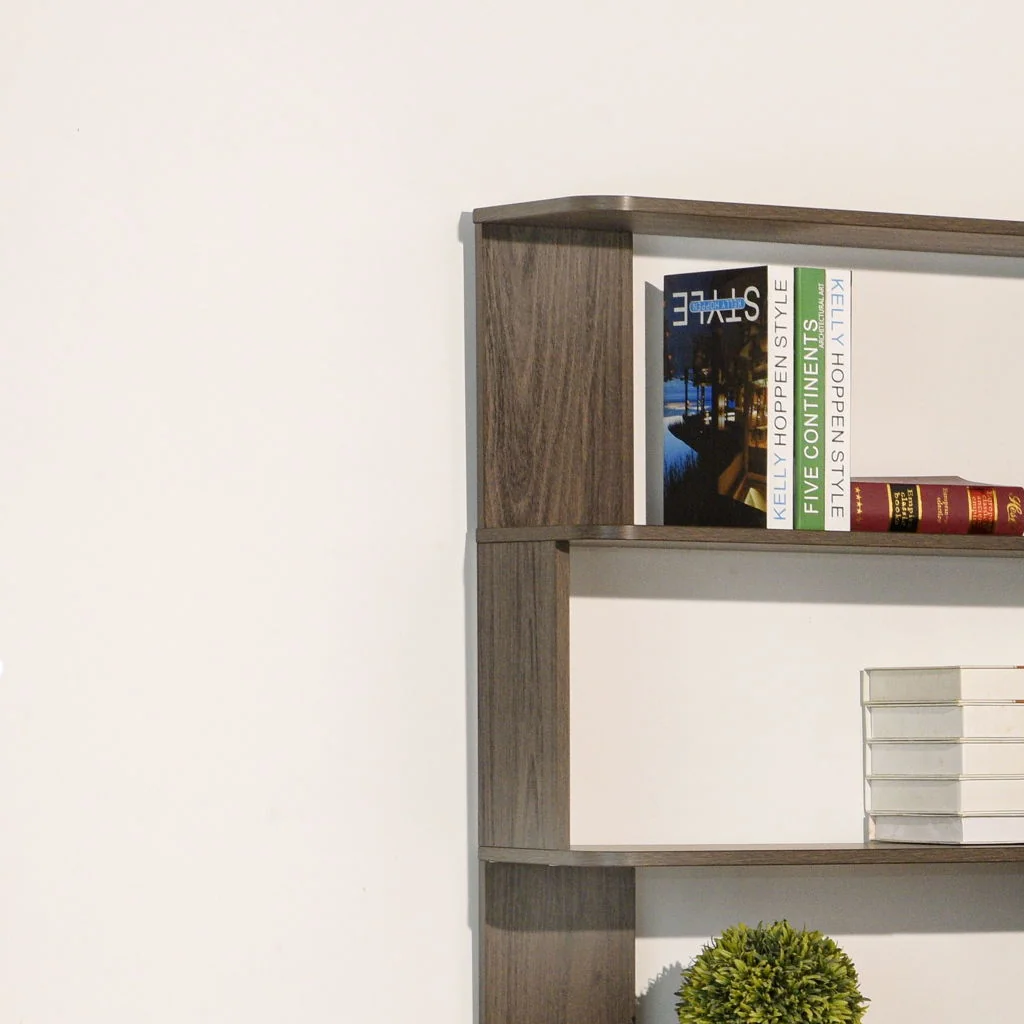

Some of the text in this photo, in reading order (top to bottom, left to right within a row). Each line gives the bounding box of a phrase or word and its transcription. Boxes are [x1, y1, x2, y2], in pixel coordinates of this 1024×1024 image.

[672, 285, 760, 327] STYLE
[773, 279, 788, 520] KELLY HOPPEN STYLE
[831, 278, 845, 518] KELLY HOPPEN STYLE
[803, 319, 819, 514] FIVE CONTINENTS
